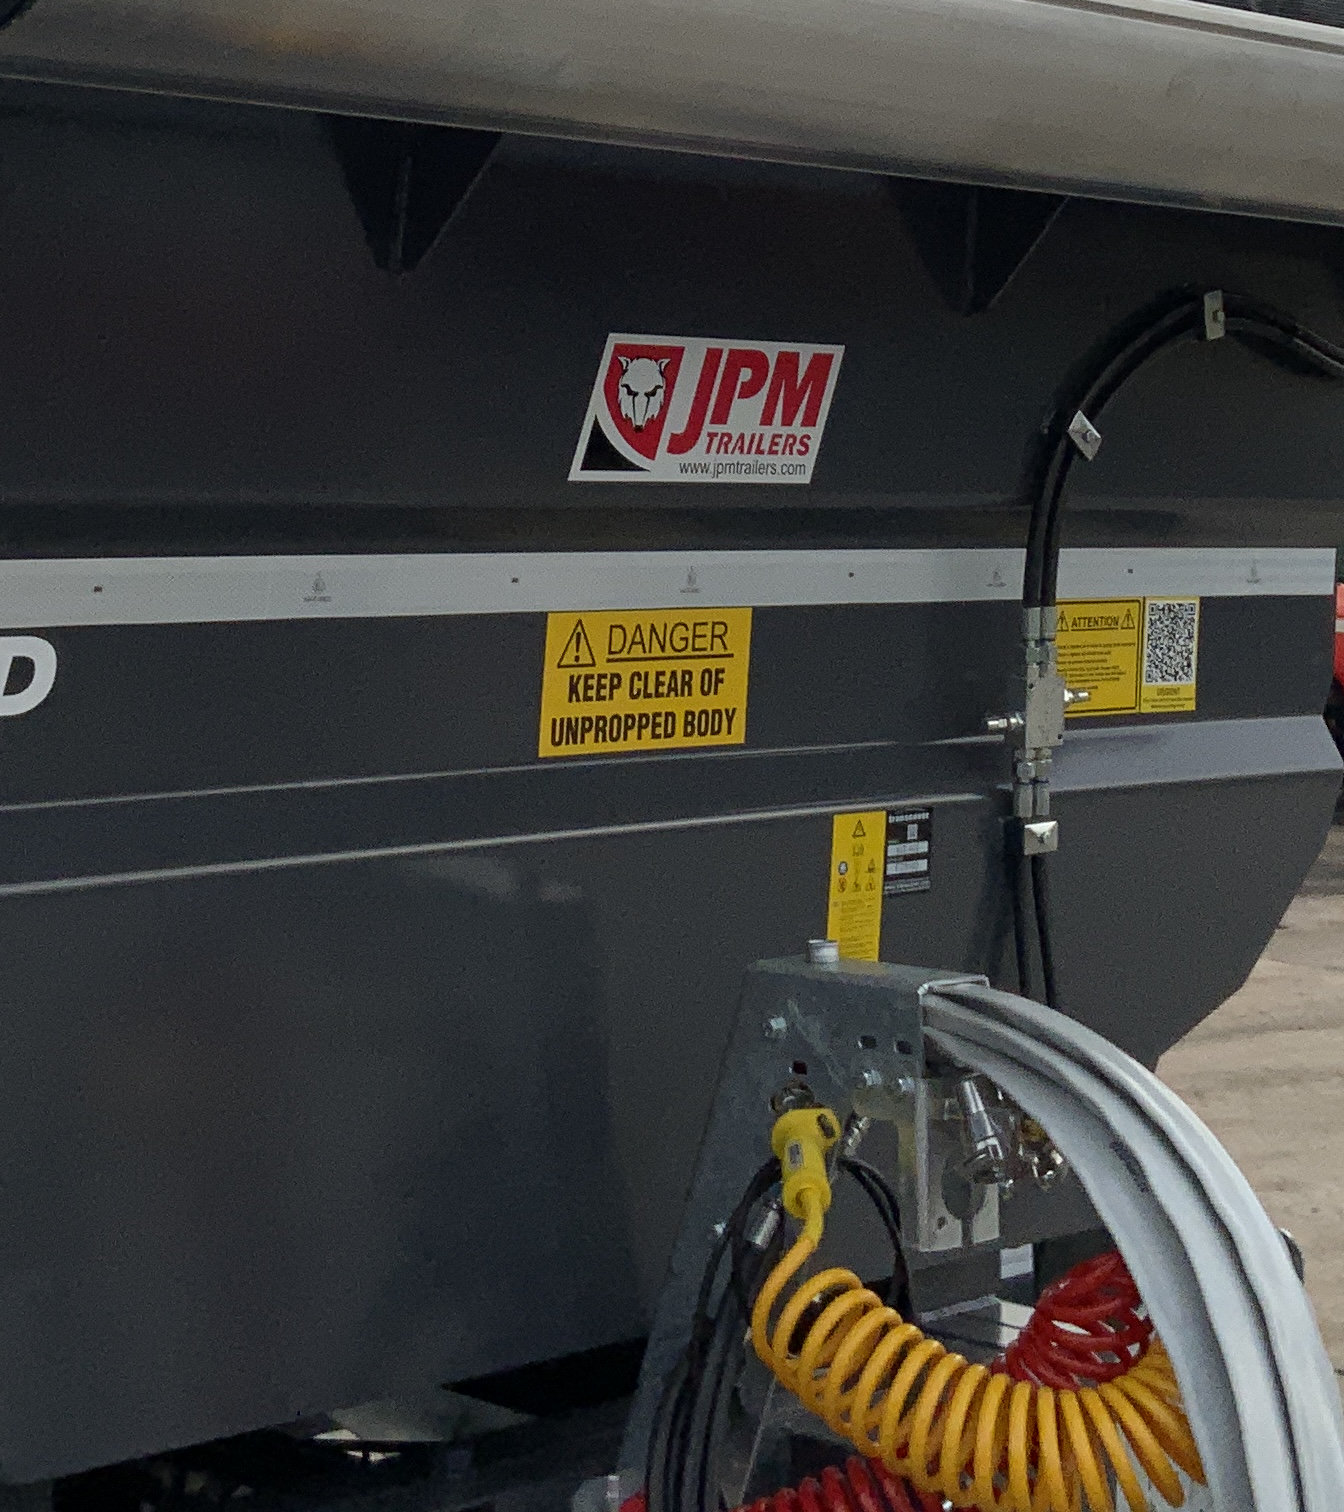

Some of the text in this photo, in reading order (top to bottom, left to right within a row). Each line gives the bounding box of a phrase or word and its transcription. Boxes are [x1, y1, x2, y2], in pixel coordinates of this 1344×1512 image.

[666, 347, 835, 455] JPM
[705, 431, 812, 456] TRAILERS
[679, 459, 807, 479] www.jpmtrailers.com
[607, 621, 729, 656] DANGER
[1071, 615, 1119, 628] ATTENTION
[567, 667, 726, 704] KEEP CLEAR OF
[550, 707, 737, 747] UNPROPPED BODY
